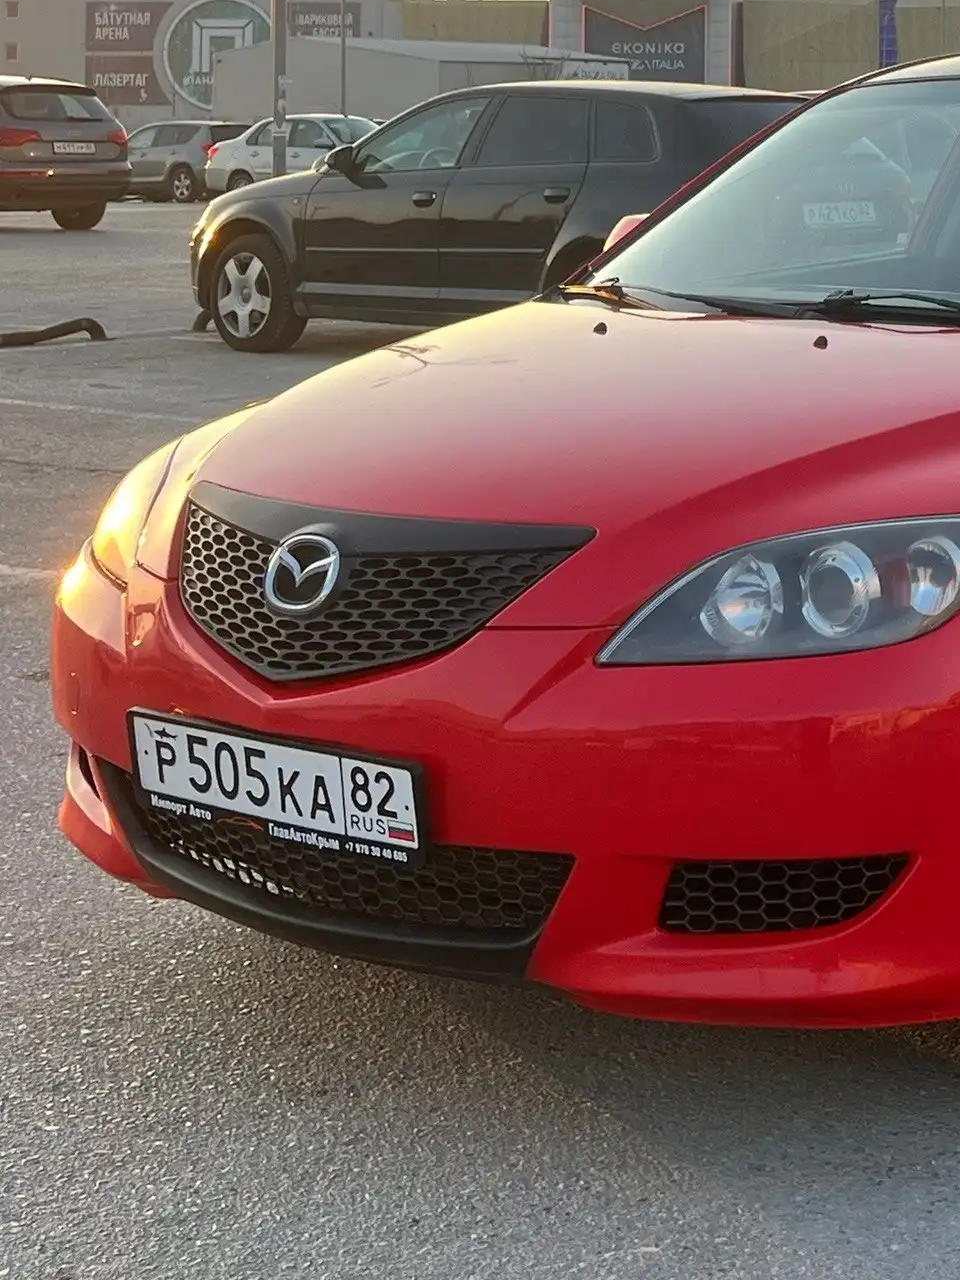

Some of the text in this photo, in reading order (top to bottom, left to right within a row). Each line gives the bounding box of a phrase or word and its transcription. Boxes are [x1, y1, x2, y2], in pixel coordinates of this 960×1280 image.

[94, 11, 151, 26] БАТУТНАЯ
[94, 26, 130, 41] АРЕНА
[93, 73, 149, 87] ЛАЗЕРТАГ
[155, 733, 398, 824] Р505КА 82
[150, 794, 212, 821] Импорт Авто
[350, 814, 387, 836] RUS
[268, 822, 340, 851] ГлавАвтоКрым
[345, 841, 354, 852] +7
